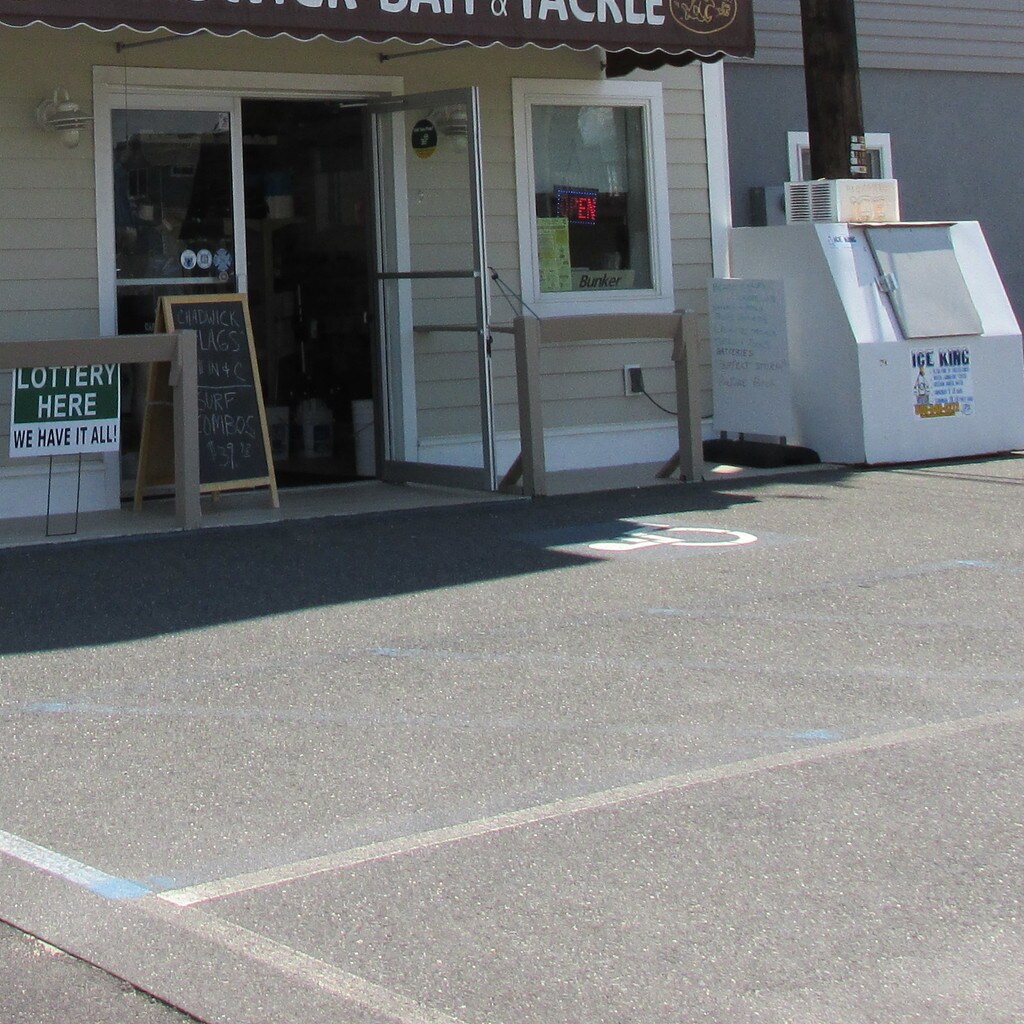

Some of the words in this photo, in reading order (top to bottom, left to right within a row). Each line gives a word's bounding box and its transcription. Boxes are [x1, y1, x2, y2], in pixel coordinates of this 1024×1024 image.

[579, 273, 623, 288] Bunker
[177, 309, 240, 327] CHADWICK
[199, 328, 243, 351] LAGS
[911, 350, 934, 368] ICE
[939, 348, 970, 367] KING
[17, 363, 116, 389] LOTTERY
[38, 392, 97, 419] HERE
[14, 429, 33, 449] WE
[38, 427, 71, 448] HAVE
[76, 426, 88, 445] IT
[91, 424, 117, 444] ALL!
